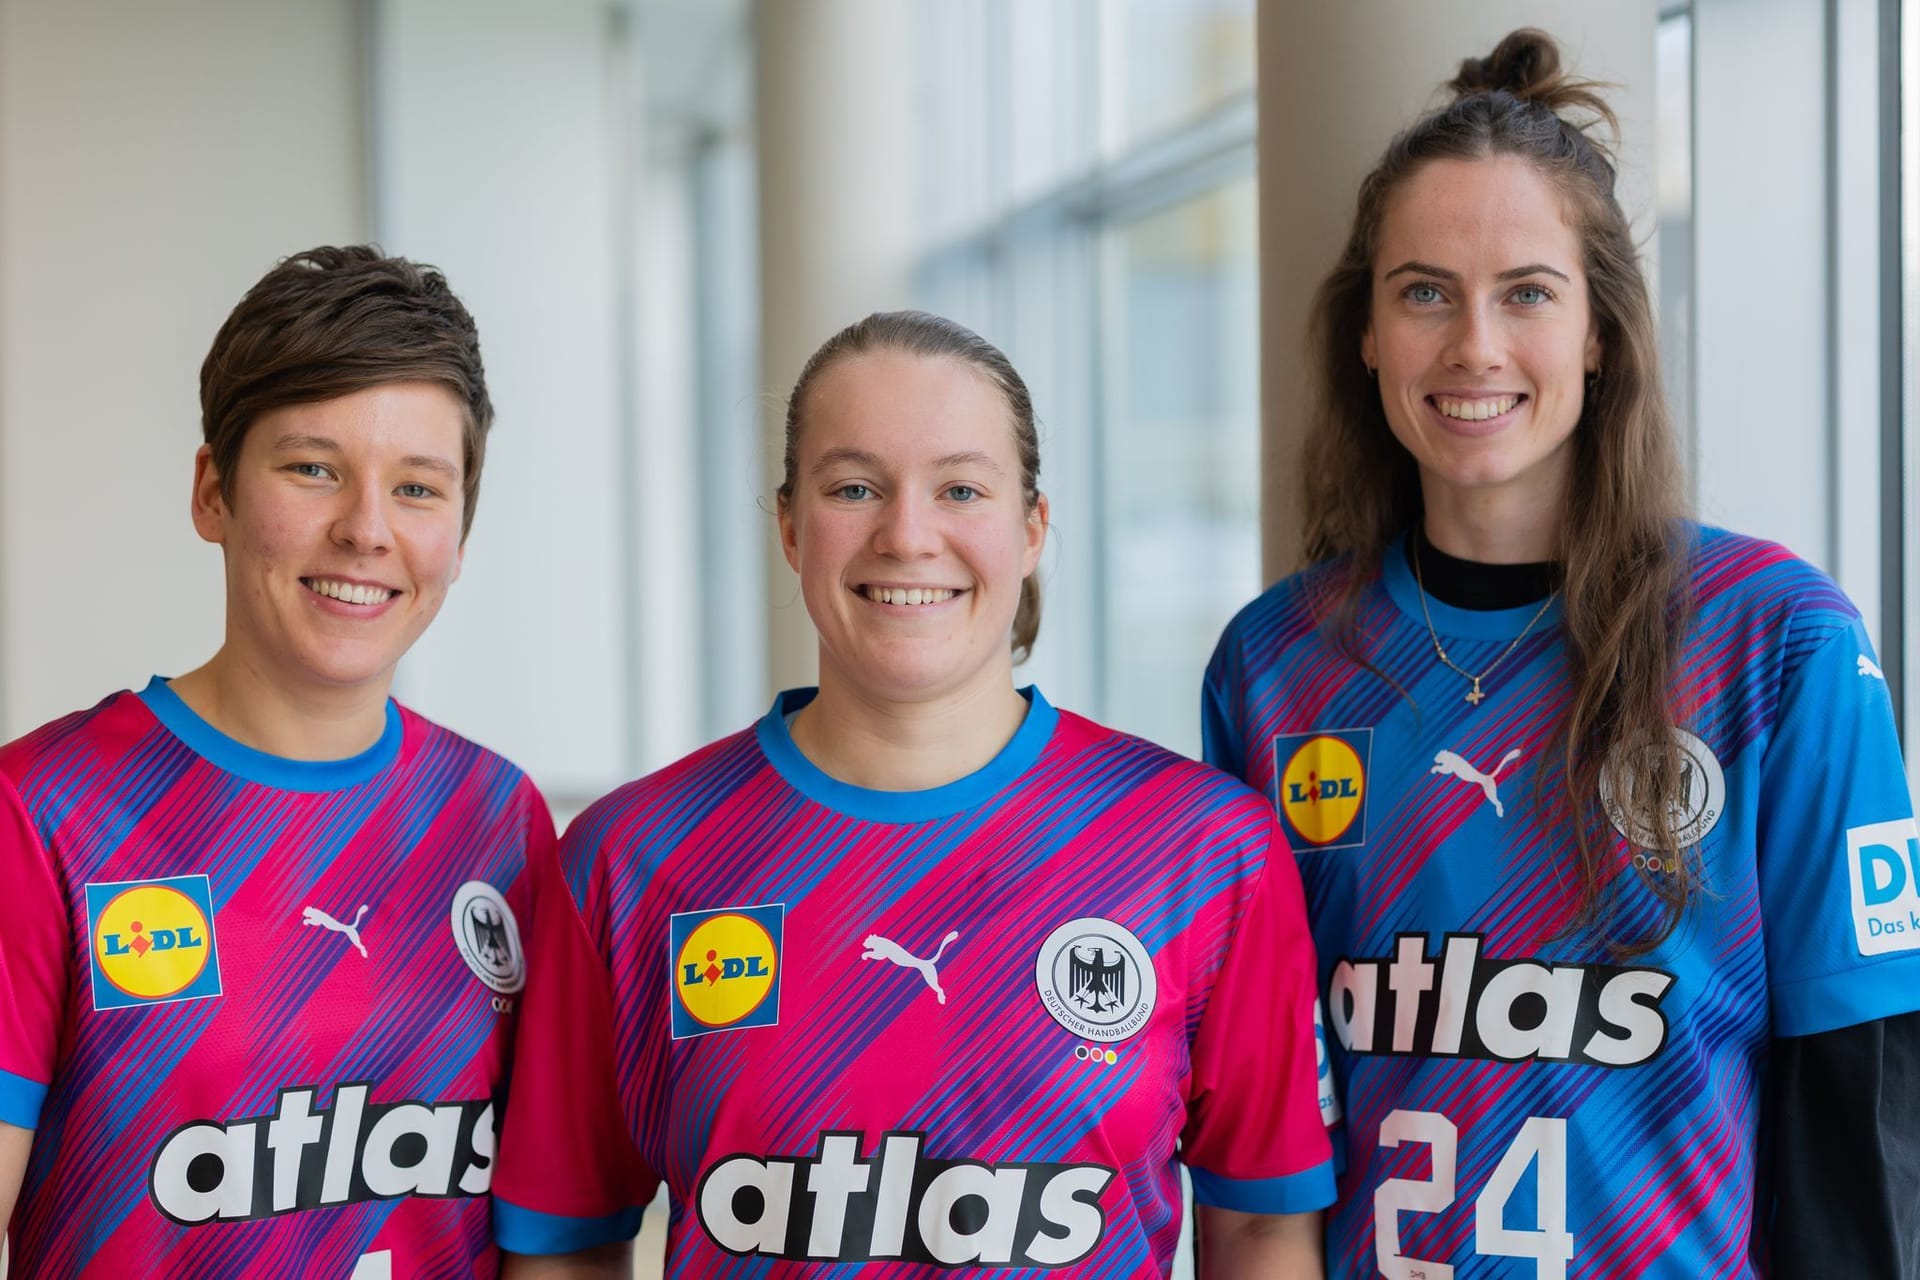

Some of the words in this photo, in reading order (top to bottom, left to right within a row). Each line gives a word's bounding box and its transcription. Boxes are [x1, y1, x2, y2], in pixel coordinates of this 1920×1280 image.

[1868, 918, 1904, 936] Das
[1044, 989, 1085, 1033] DEUTSCHER
[1087, 1002, 1149, 1037] HANDBALLBUND
[1329, 936, 1673, 1066] atlas
[153, 1084, 498, 1223] atlas
[700, 1135, 1112, 1266] atlas
[1373, 1108, 1574, 1280] 24
